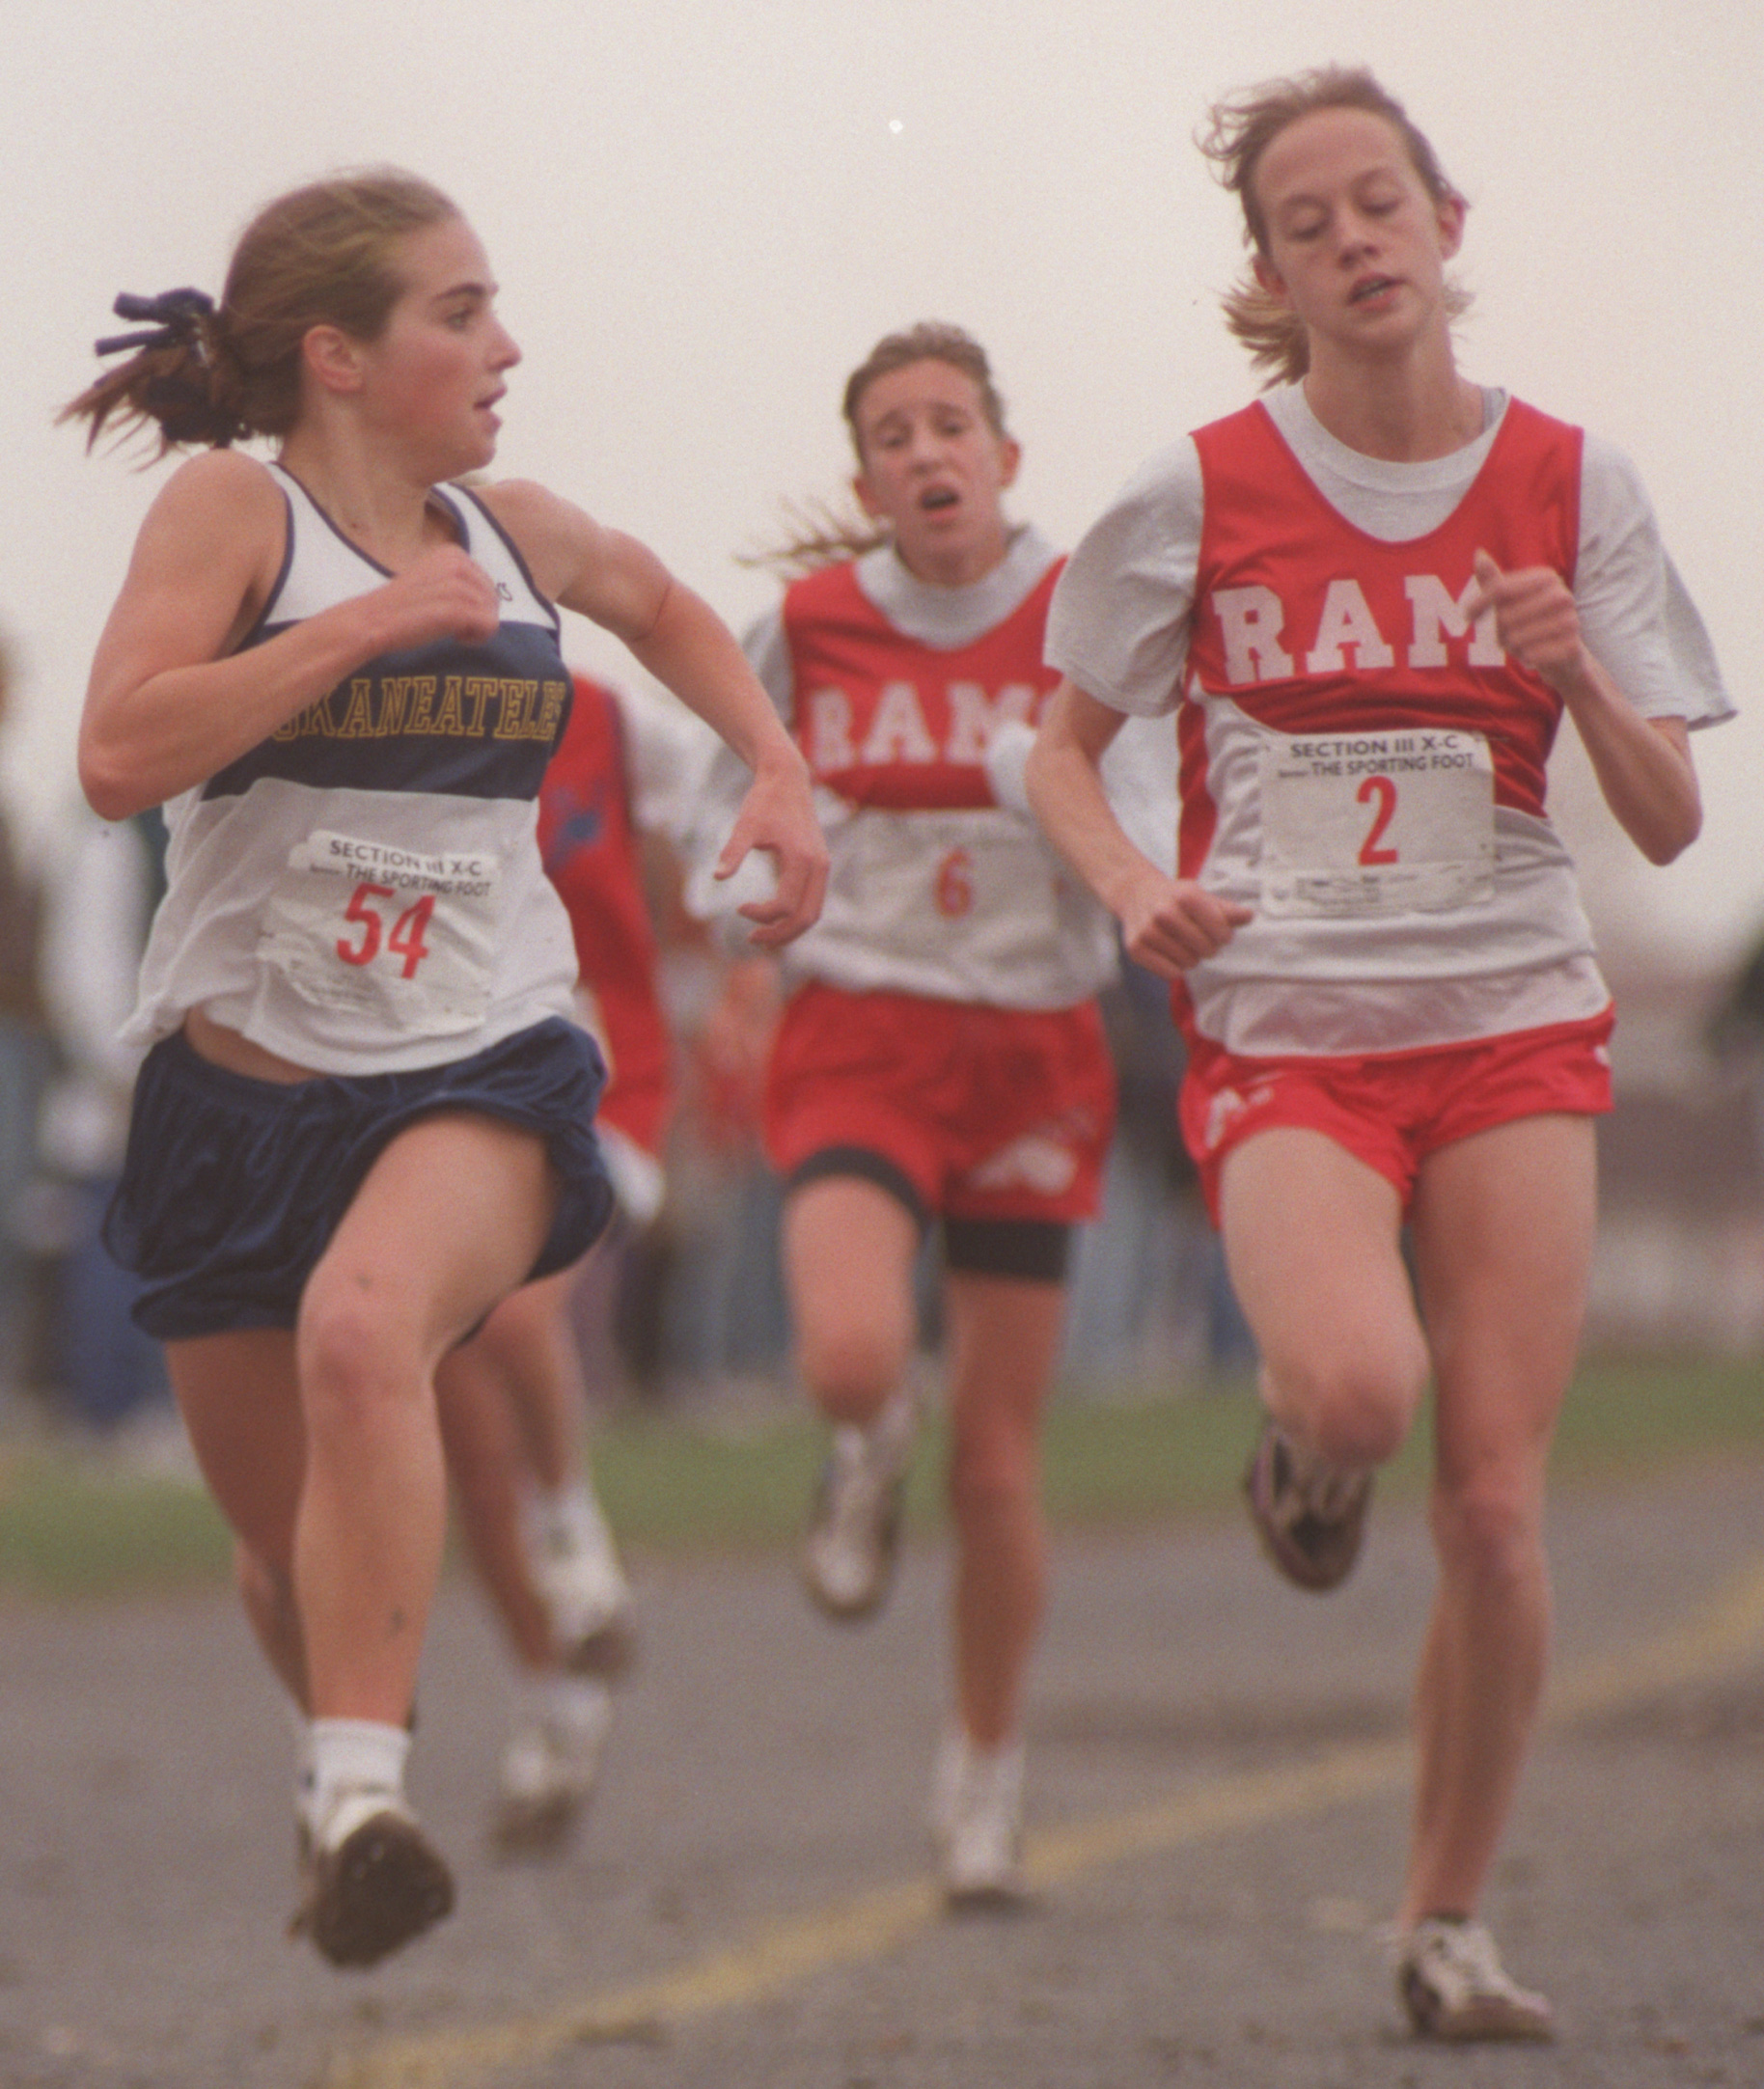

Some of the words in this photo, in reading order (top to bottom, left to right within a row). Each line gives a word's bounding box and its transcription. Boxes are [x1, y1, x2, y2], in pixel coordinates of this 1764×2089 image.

[272, 675, 565, 741] KANEATELE
[809, 680, 1052, 771] RAM
[1290, 740, 1387, 757] SECTION
[1394, 738, 1414, 752] III
[1421, 734, 1458, 751] X-C
[1311, 761, 1341, 776] THE
[1347, 756, 1426, 773] SPORTING
[1431, 753, 1474, 770] FOOT
[1356, 775, 1398, 866] 2
[330, 839, 420, 869] SECTION
[346, 863, 377, 883] THE
[382, 870, 454, 893] SPORTING
[455, 882, 492, 897] FOOT
[935, 846, 971, 921] 6
[337, 881, 437, 979] 54
